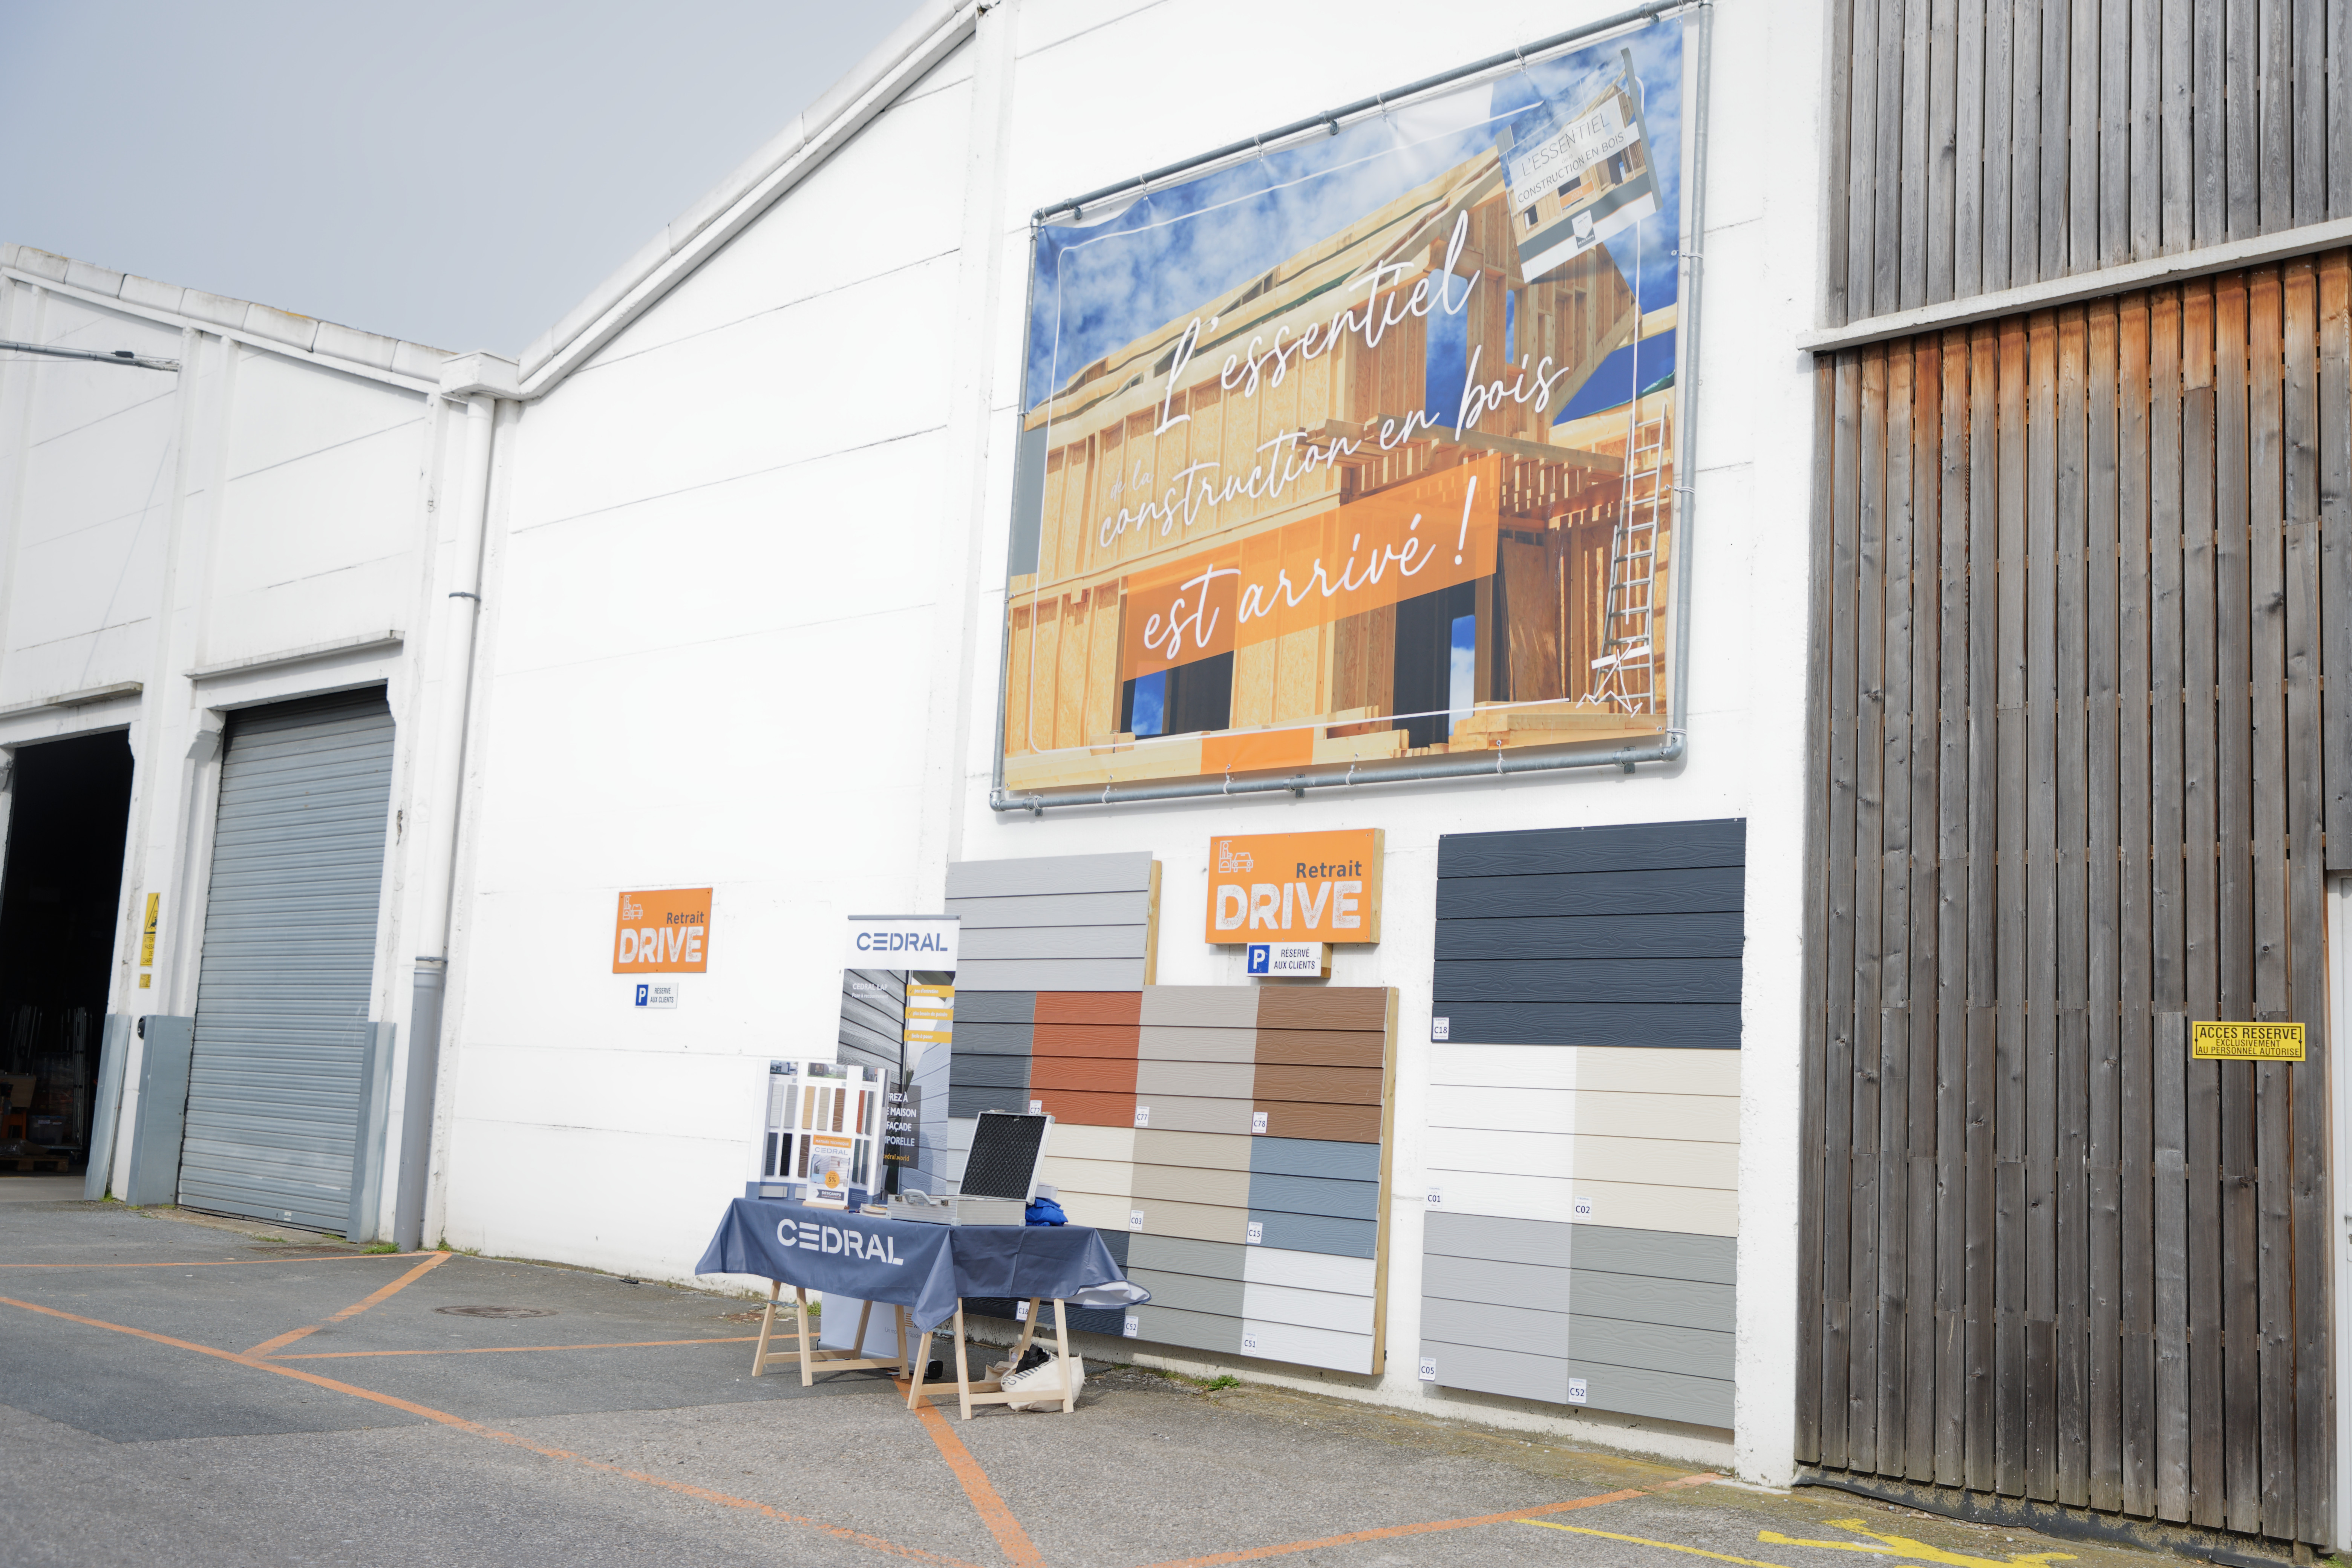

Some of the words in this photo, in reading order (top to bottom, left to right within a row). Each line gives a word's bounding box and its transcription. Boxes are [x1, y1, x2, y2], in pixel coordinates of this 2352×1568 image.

[1522, 113, 1610, 177] L'ESSENTIEL
[1518, 155, 1585, 203] CONSTRUCTION
[1586, 146, 1599, 161] EN
[1602, 132, 1624, 152] BOIS
[1570, 189, 1583, 201] 2024
[1153, 209, 1480, 436] L'essentiel
[1100, 429, 1362, 548] construction
[1379, 409, 1440, 450] en
[1455, 344, 1570, 441] bois
[1110, 470, 1126, 502] de
[1132, 459, 1155, 491] la
[1143, 564, 1241, 659] est
[1238, 513, 1436, 623] arrivé
[1296, 860, 1362, 878] Retrait
[1216, 880, 1362, 930] DRIVE
[666, 911, 704, 924] Retrait
[619, 926, 704, 963] DRIVE
[856, 932, 948, 951] CEDRAL
[1253, 949, 1266, 969] P
[1281, 947, 1309, 957] RÉSERVÉ
[638, 988, 646, 1003] P
[2200, 1027, 2237, 1038] ACCES
[2242, 1027, 2297, 1040] RESERVE
[2216, 1039, 2280, 1047] EXCLUSIVEMENT
[903, 1091, 908, 1102] À
[890, 1107, 917, 1118] MAISON
[886, 1121, 912, 1132] FAÇADE
[884, 1135, 915, 1147] PORELLE
[815, 1147, 848, 1155] CEDRAL
[1576, 1205, 1590, 1214] C02
[777, 1219, 904, 1266] CEDRAL
[1421, 1366, 1434, 1375] C05
[1570, 1388, 1584, 1396] C52
